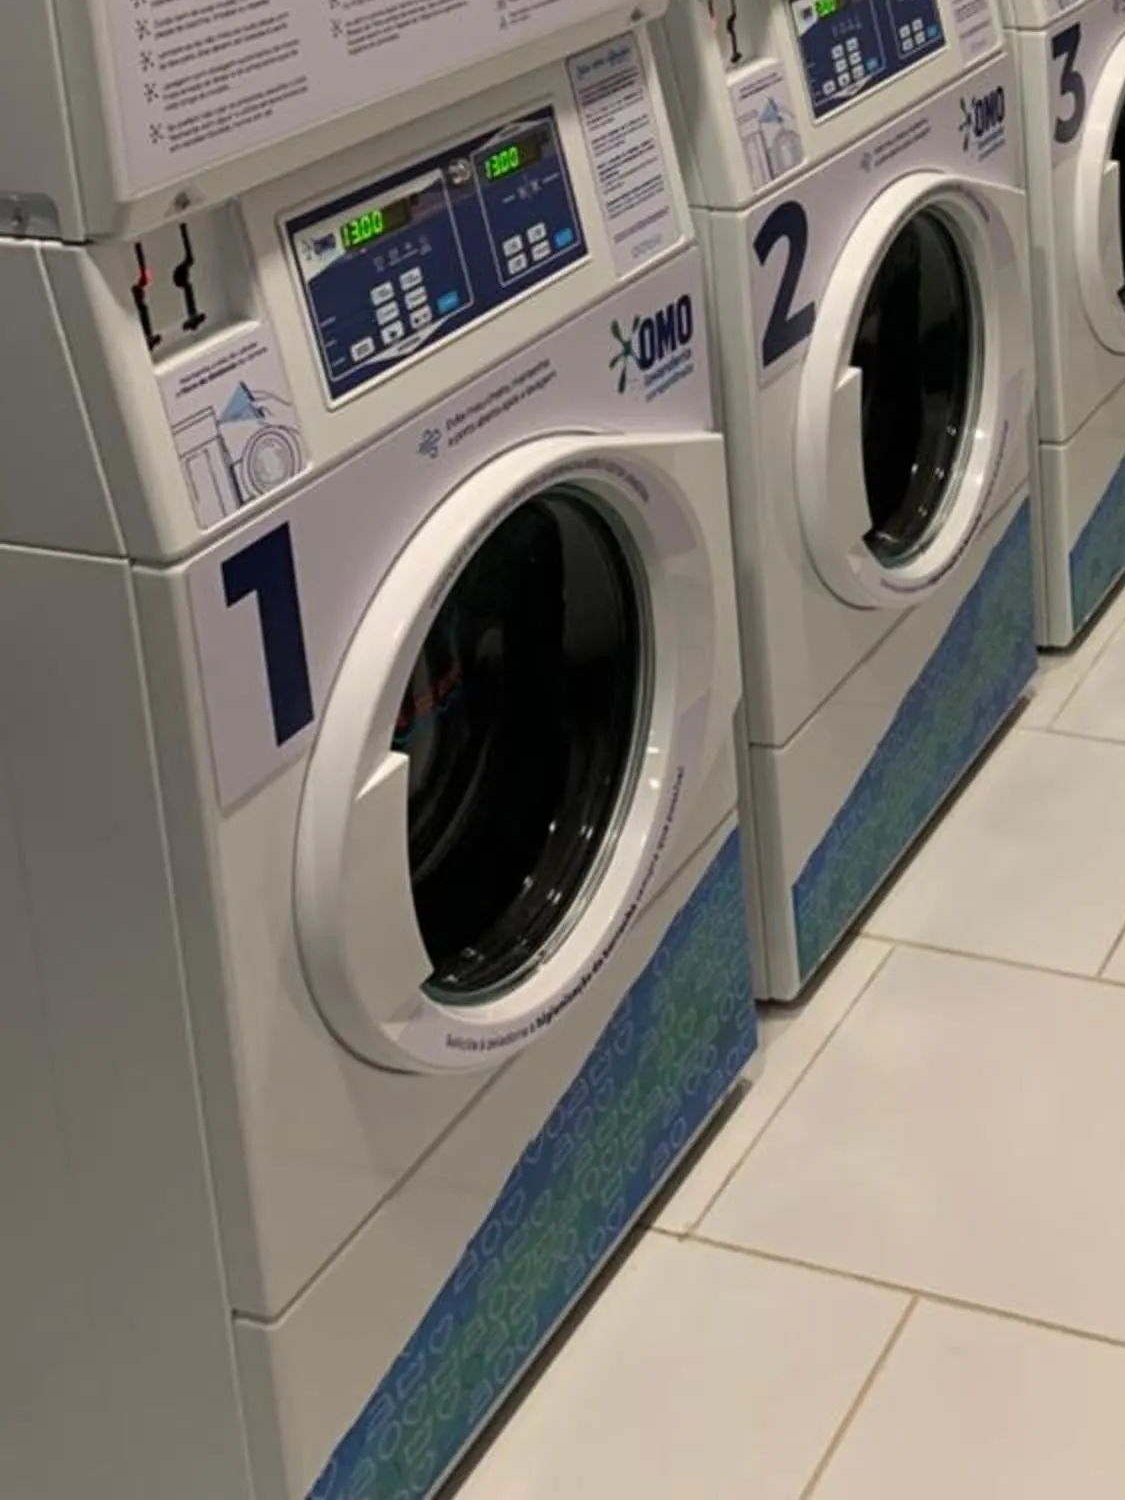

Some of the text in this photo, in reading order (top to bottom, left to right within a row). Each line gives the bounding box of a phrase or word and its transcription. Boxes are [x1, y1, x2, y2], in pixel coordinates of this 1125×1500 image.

[1051, 23, 1085, 144] 3
[636, 293, 693, 371] OMO
[752, 200, 816, 368] 2
[220, 520, 315, 748] 1
